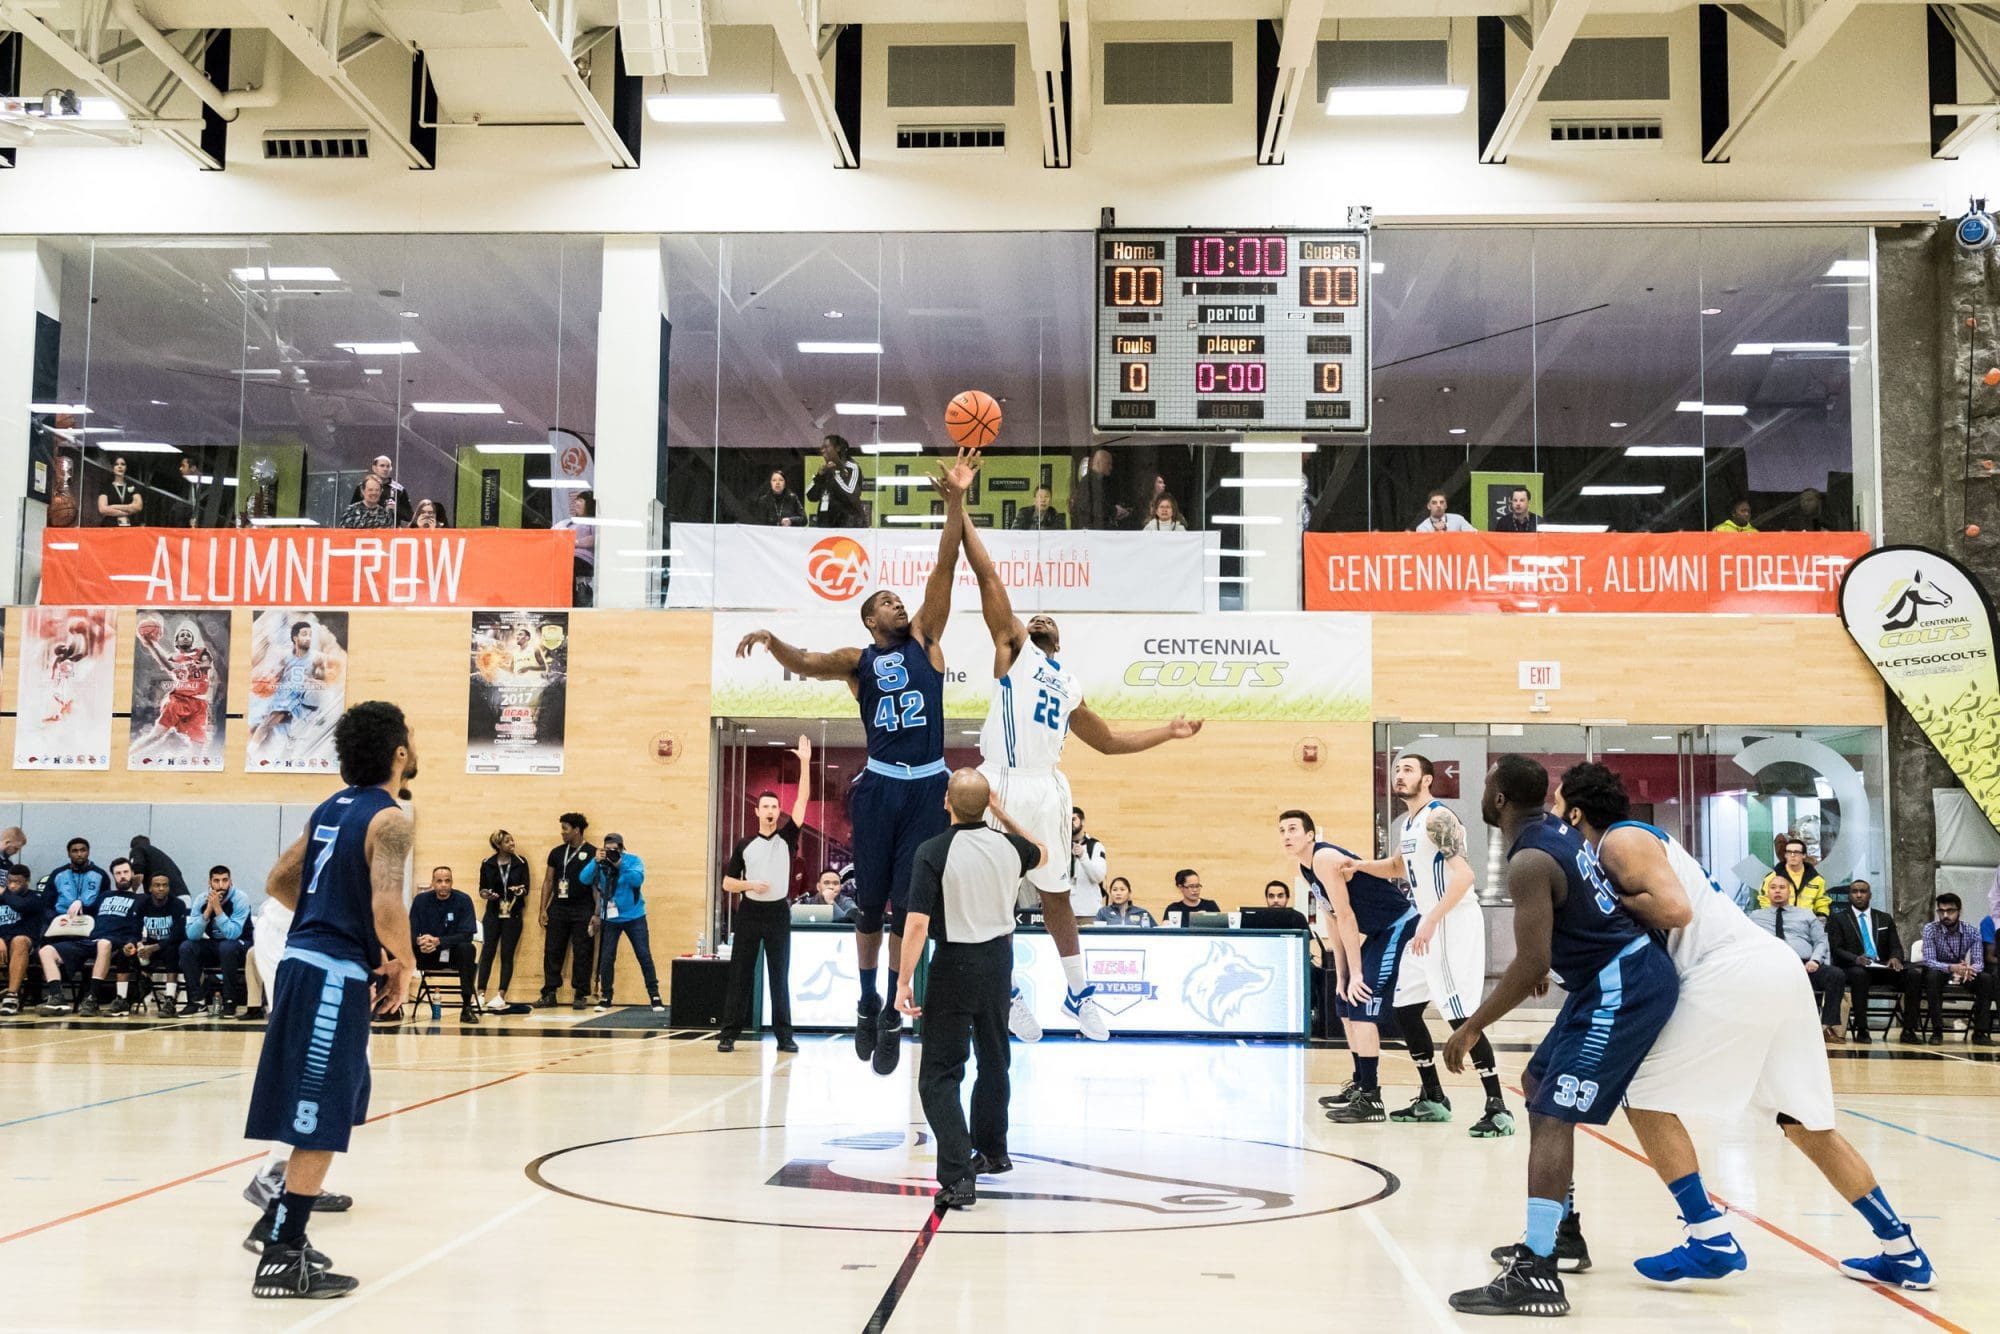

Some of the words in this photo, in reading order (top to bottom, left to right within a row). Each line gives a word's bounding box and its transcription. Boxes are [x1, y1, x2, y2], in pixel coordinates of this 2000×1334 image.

[1113, 242, 1155, 260] Home
[1192, 238, 1286, 275] 10:00
[1304, 242, 1356, 260] Guests
[1114, 267, 1162, 305] 00
[1308, 267, 1357, 305] 00
[1207, 307, 1257, 324] period
[1116, 337, 1152, 353] fouls
[1207, 336, 1256, 355] player
[1129, 364, 1147, 391] 0
[1198, 364, 1264, 391] 0-00
[1323, 364, 1340, 392] 0
[1120, 403, 1148, 416] won
[1212, 404, 1250, 417] game
[1315, 404, 1343, 417] won
[146, 536, 331, 603] ALUMNI
[352, 537, 466, 603] ROW
[1328, 554, 1497, 593] CENTENNIAL
[1507, 555, 1593, 595] FIRST,
[1603, 554, 1708, 593] ALUMNI
[1720, 554, 1848, 593] FOREVER
[1920, 616, 1970, 628] CENTENNIAL
[1144, 638, 1281, 655] CENTENNIAL
[1879, 623, 1972, 648] COLTS
[1877, 648, 1987, 668] #LETSGOCOLTS
[873, 651, 909, 693] S
[1123, 660, 1289, 687] COLTS
[1530, 666, 1552, 685] EXIT
[500, 692, 533, 706] 2017
[874, 690, 926, 732] 42
[1034, 689, 1060, 731] 22
[306, 825, 340, 894] 7
[1107, 982, 1142, 993] YEARS
[1553, 1073, 1600, 1113] 33
